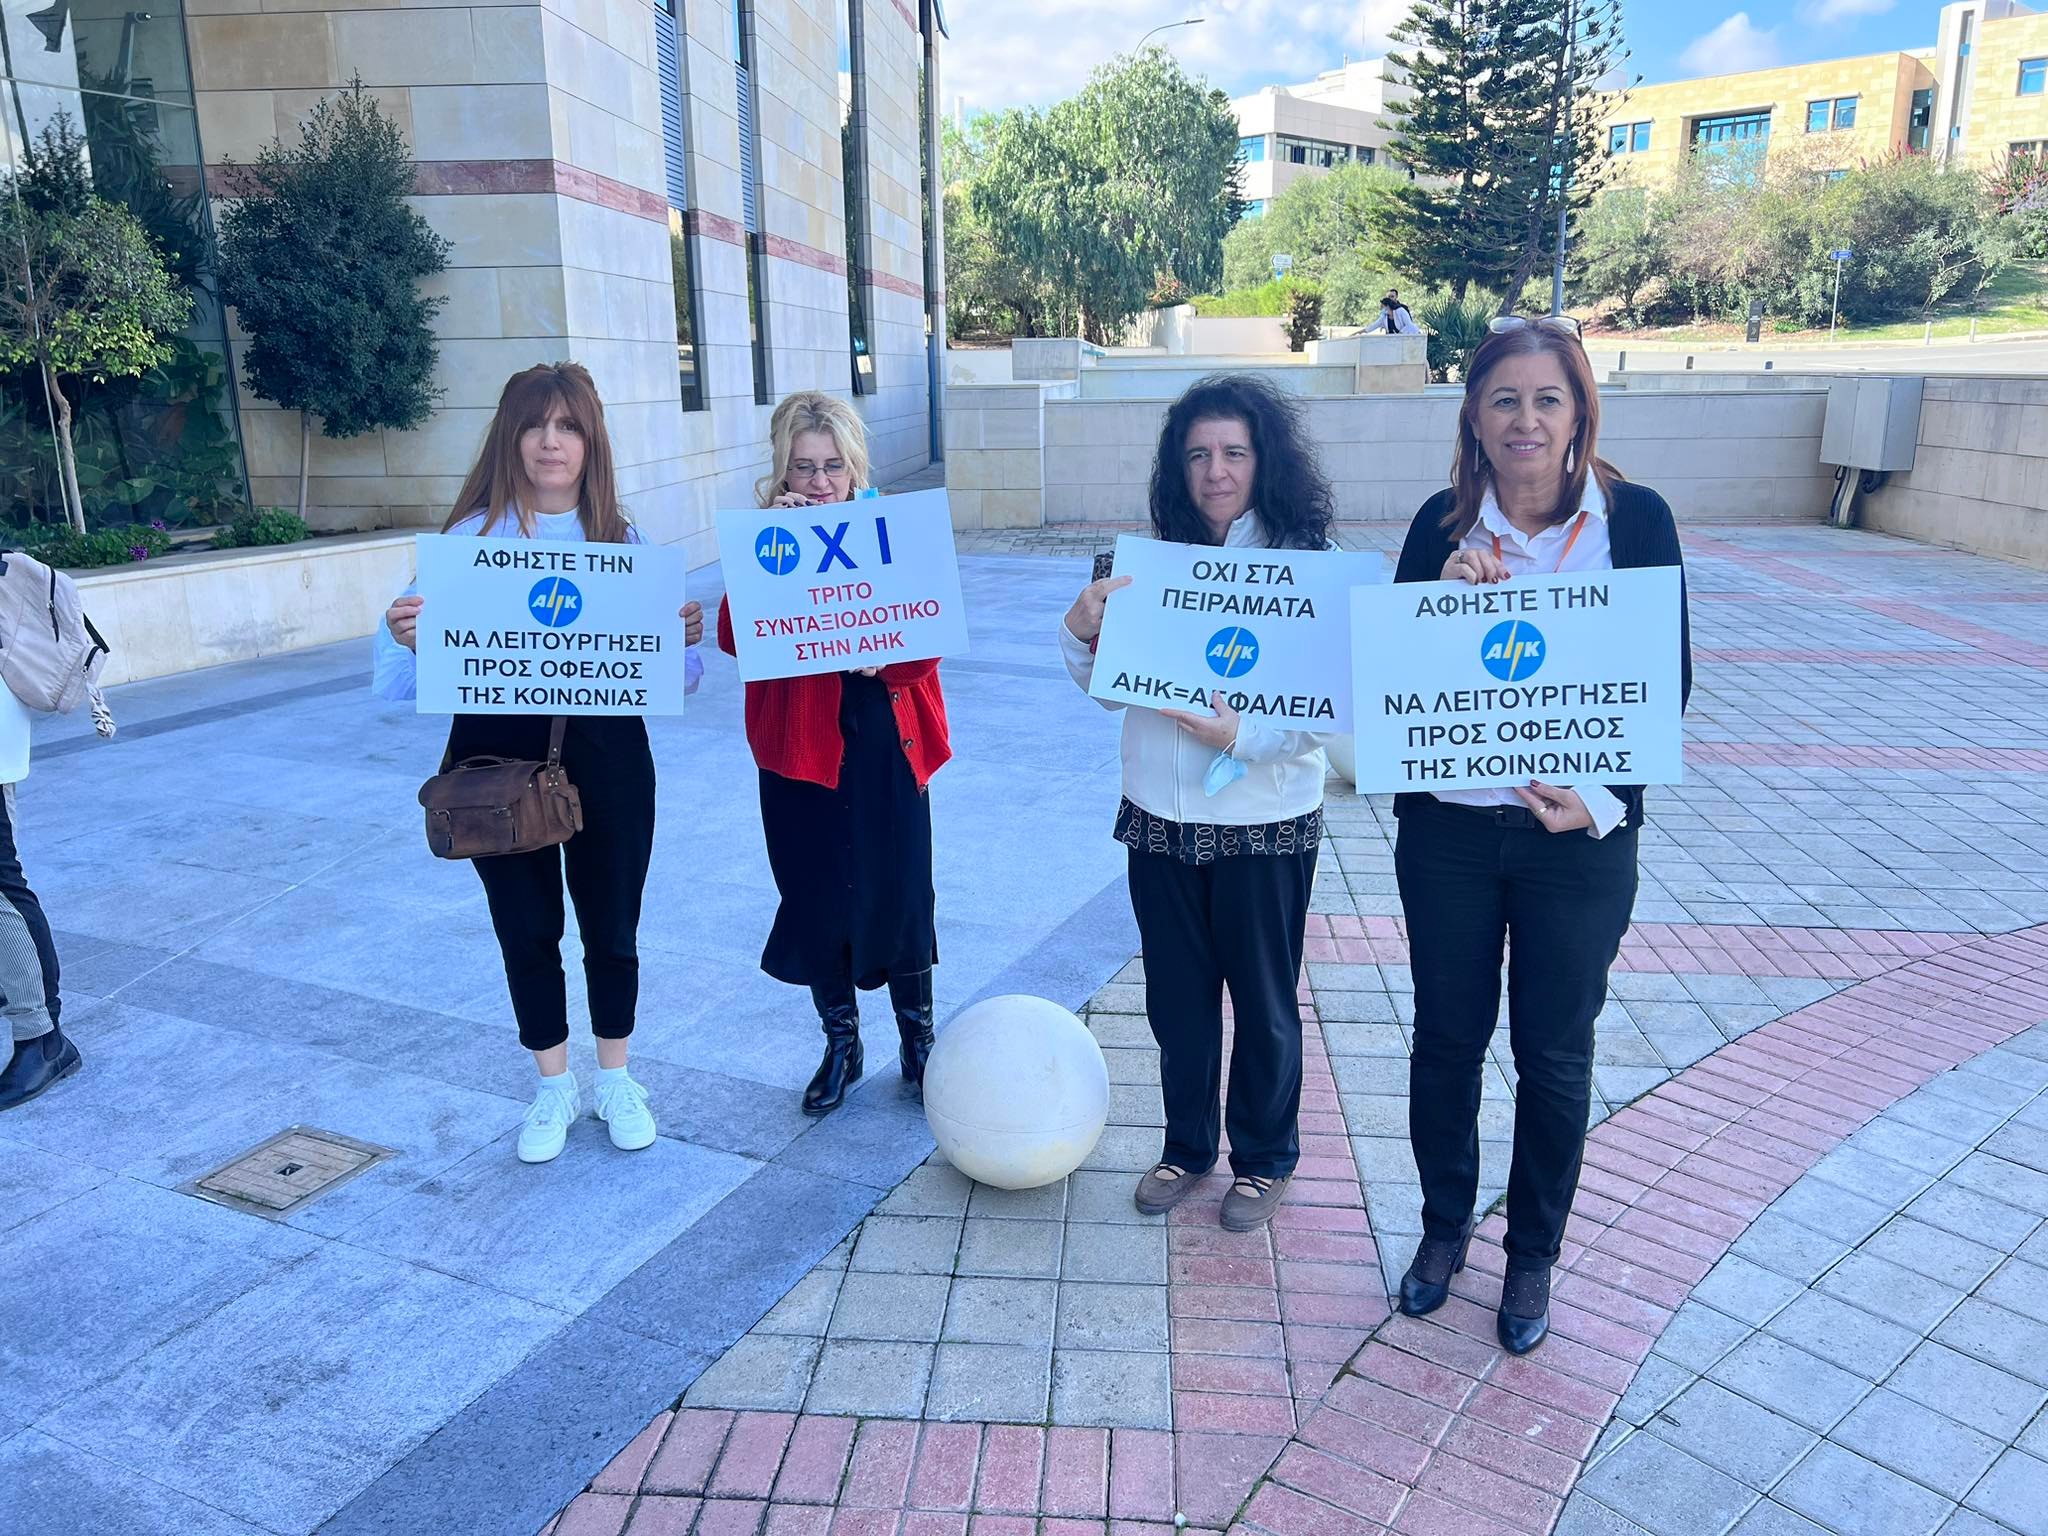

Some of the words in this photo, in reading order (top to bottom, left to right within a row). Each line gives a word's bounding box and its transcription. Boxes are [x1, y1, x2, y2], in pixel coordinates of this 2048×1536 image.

[473, 549, 577, 571] ΑΦΗΣΤΕ
[584, 553, 633, 574] ΤΗΝ
[1192, 560, 1238, 583] ΟΧΙ
[1245, 563, 1295, 586] ΣΤΑ
[808, 582, 873, 605] ΤΡΙΤΟ
[1162, 588, 1316, 619] ΠΕΙΡΑΜΑΤΑ
[1415, 589, 1538, 618] ΑΦΗΣΤΕ
[1547, 584, 1609, 610] ΤΗΝ
[754, 599, 940, 637] ΣΥΝΤΑΞΙΟΔΟΤΙΚΟ
[444, 629, 480, 649] ΝΑ
[486, 631, 661, 653] ΛΕΙΤΟΥΡΓΗΣΕΙ
[795, 638, 851, 661] ΣΤΗΝ
[857, 631, 905, 653] ΑΗΚ
[463, 658, 533, 678] ΠΡΟΣ
[540, 660, 643, 680] ΟΦΕΛΟΣ
[457, 686, 506, 705] ΤΗΣ
[514, 687, 648, 707] ΚΟΙΝΩΝΙΑΣ
[1384, 693, 1426, 716] ΝΑ
[1432, 681, 1647, 713] ΛΕΙΤΟΥΡΓΗΣΕΙ
[1408, 722, 1487, 747] ΠΡΟΣ
[1496, 716, 1625, 743] ΟΦΕΛΟΣ
[1400, 757, 1457, 781] ΤΗΣ
[1466, 751, 1632, 778] ΚΟΙΝΩΝΙΑΣ
